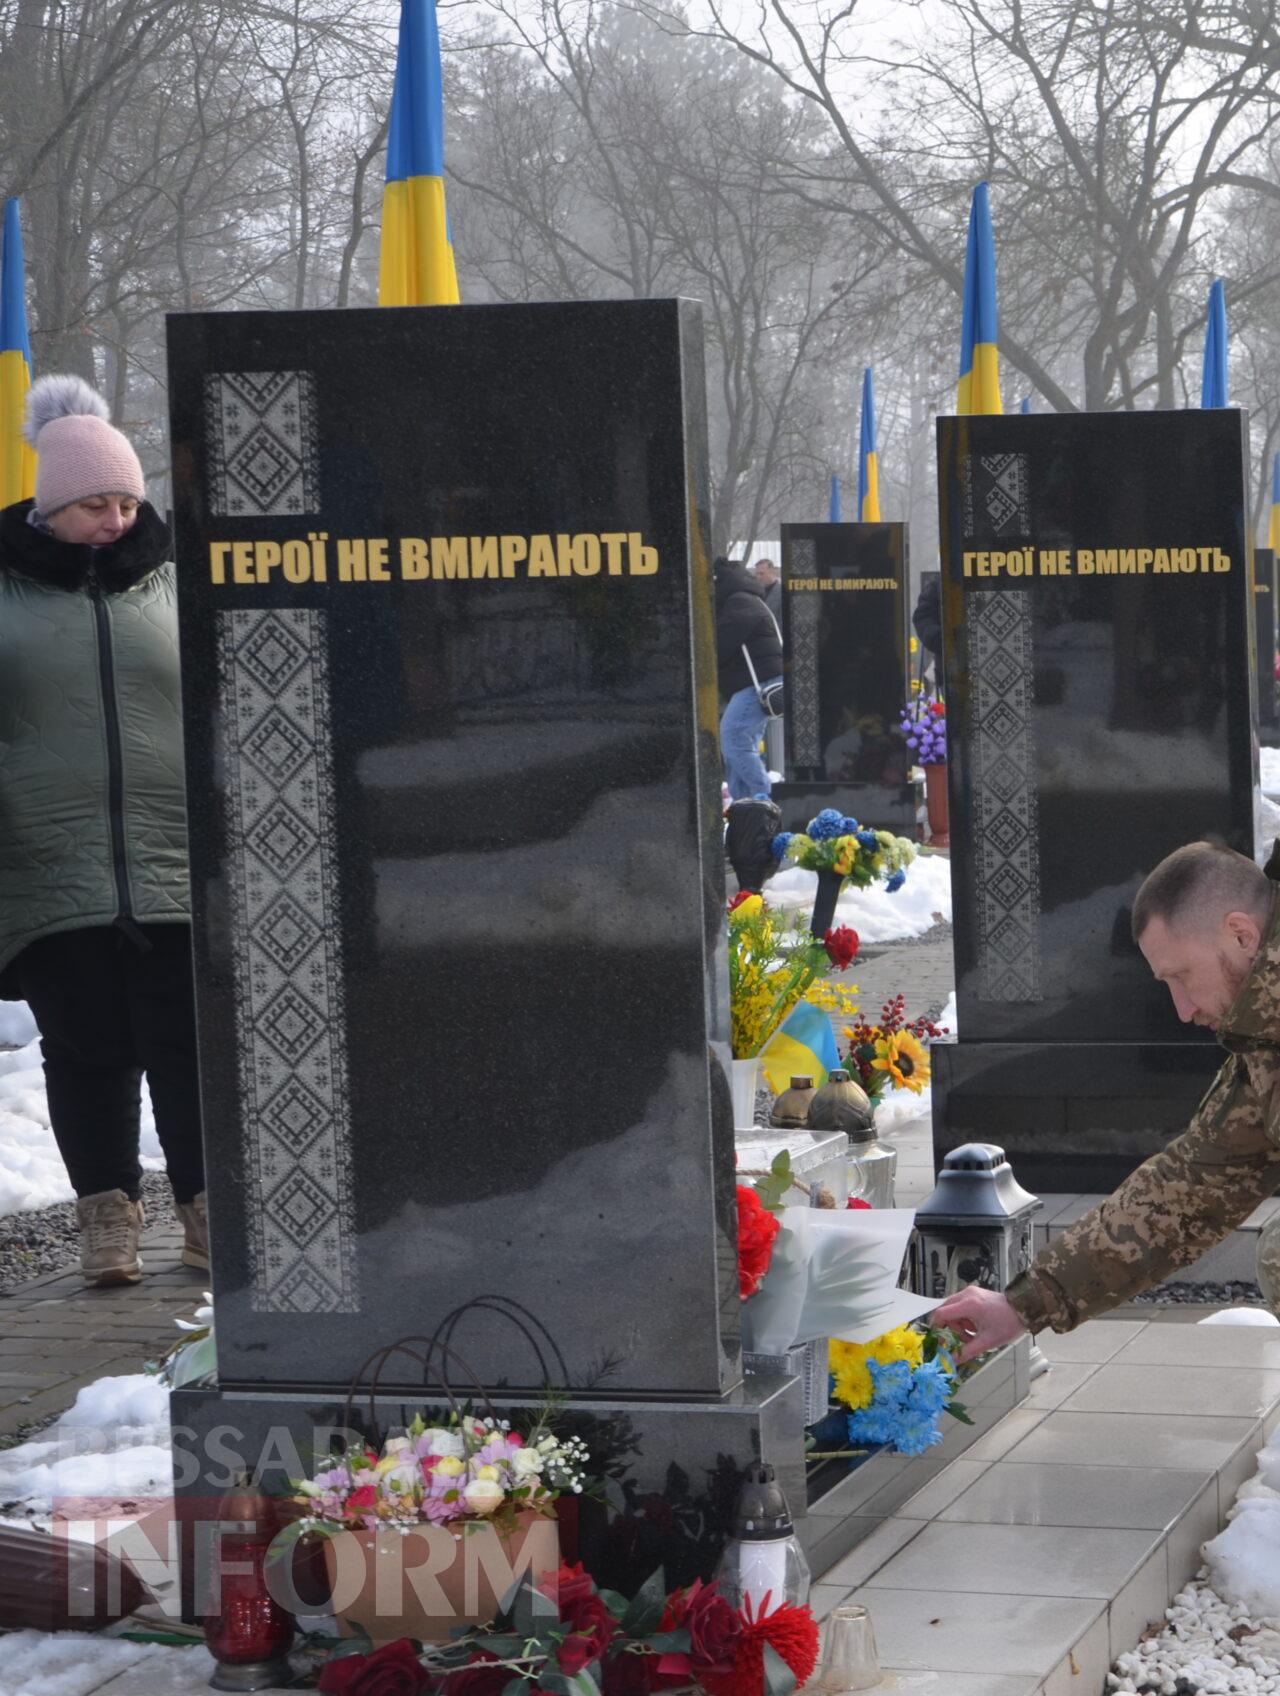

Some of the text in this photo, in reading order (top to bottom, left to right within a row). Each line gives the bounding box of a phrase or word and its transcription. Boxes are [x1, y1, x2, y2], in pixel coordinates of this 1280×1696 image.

[210, 532, 659, 584] ГЕРОЇ НЕ ВМИРАЮТЬ
[963, 547, 1231, 577] ГЕРОЇ НЕ ВМИРАЮТЬ
[819, 579, 833, 590] НЕ
[835, 579, 898, 590] ВМИРАЮТЬ
